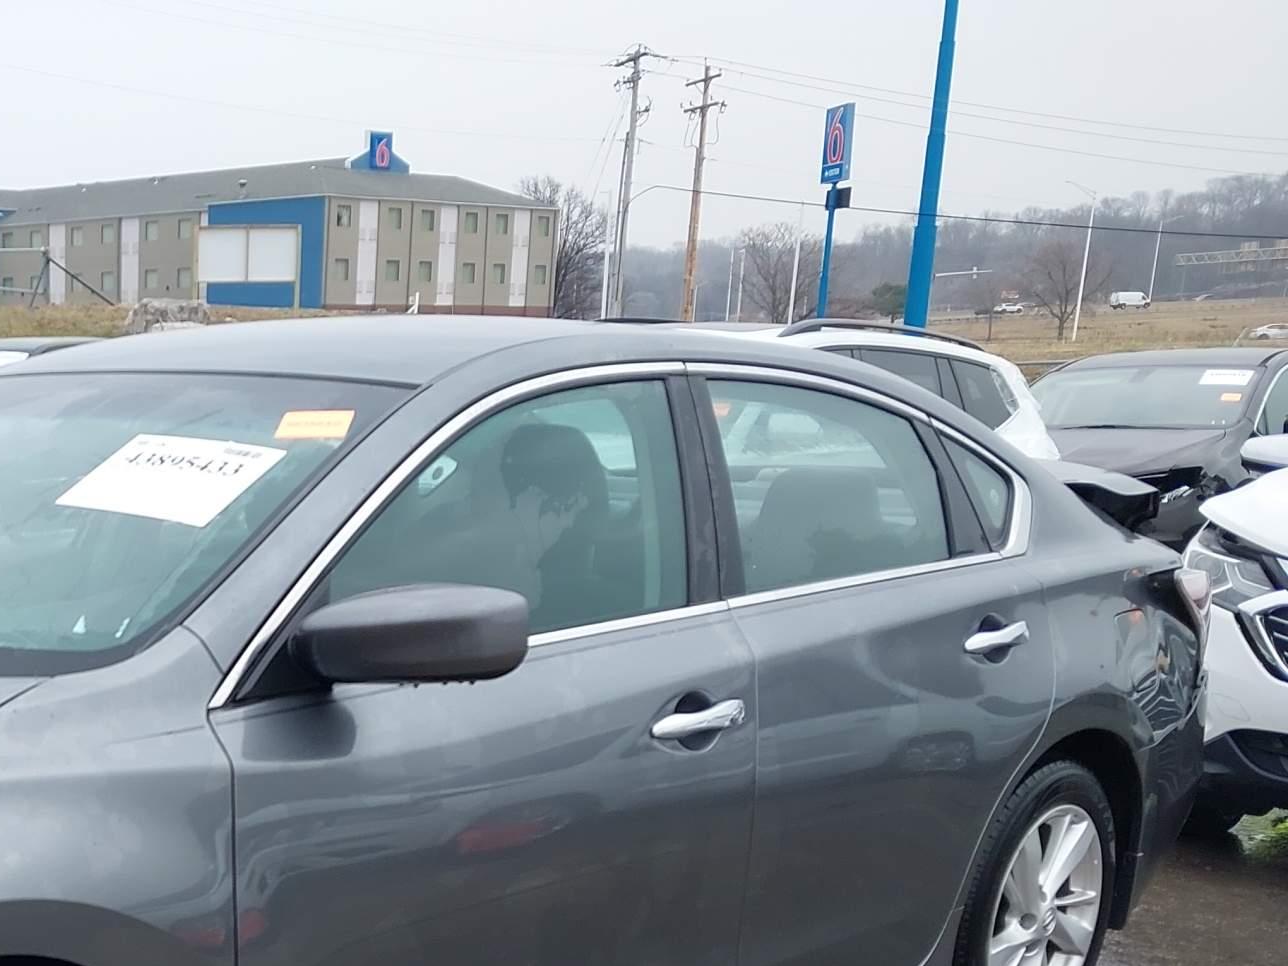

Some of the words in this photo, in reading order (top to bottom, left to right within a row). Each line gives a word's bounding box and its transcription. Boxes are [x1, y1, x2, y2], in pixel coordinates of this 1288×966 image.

[827, 106, 844, 164] 6
[375, 138, 390, 168] 6
[125, 451, 245, 477] 43895433
